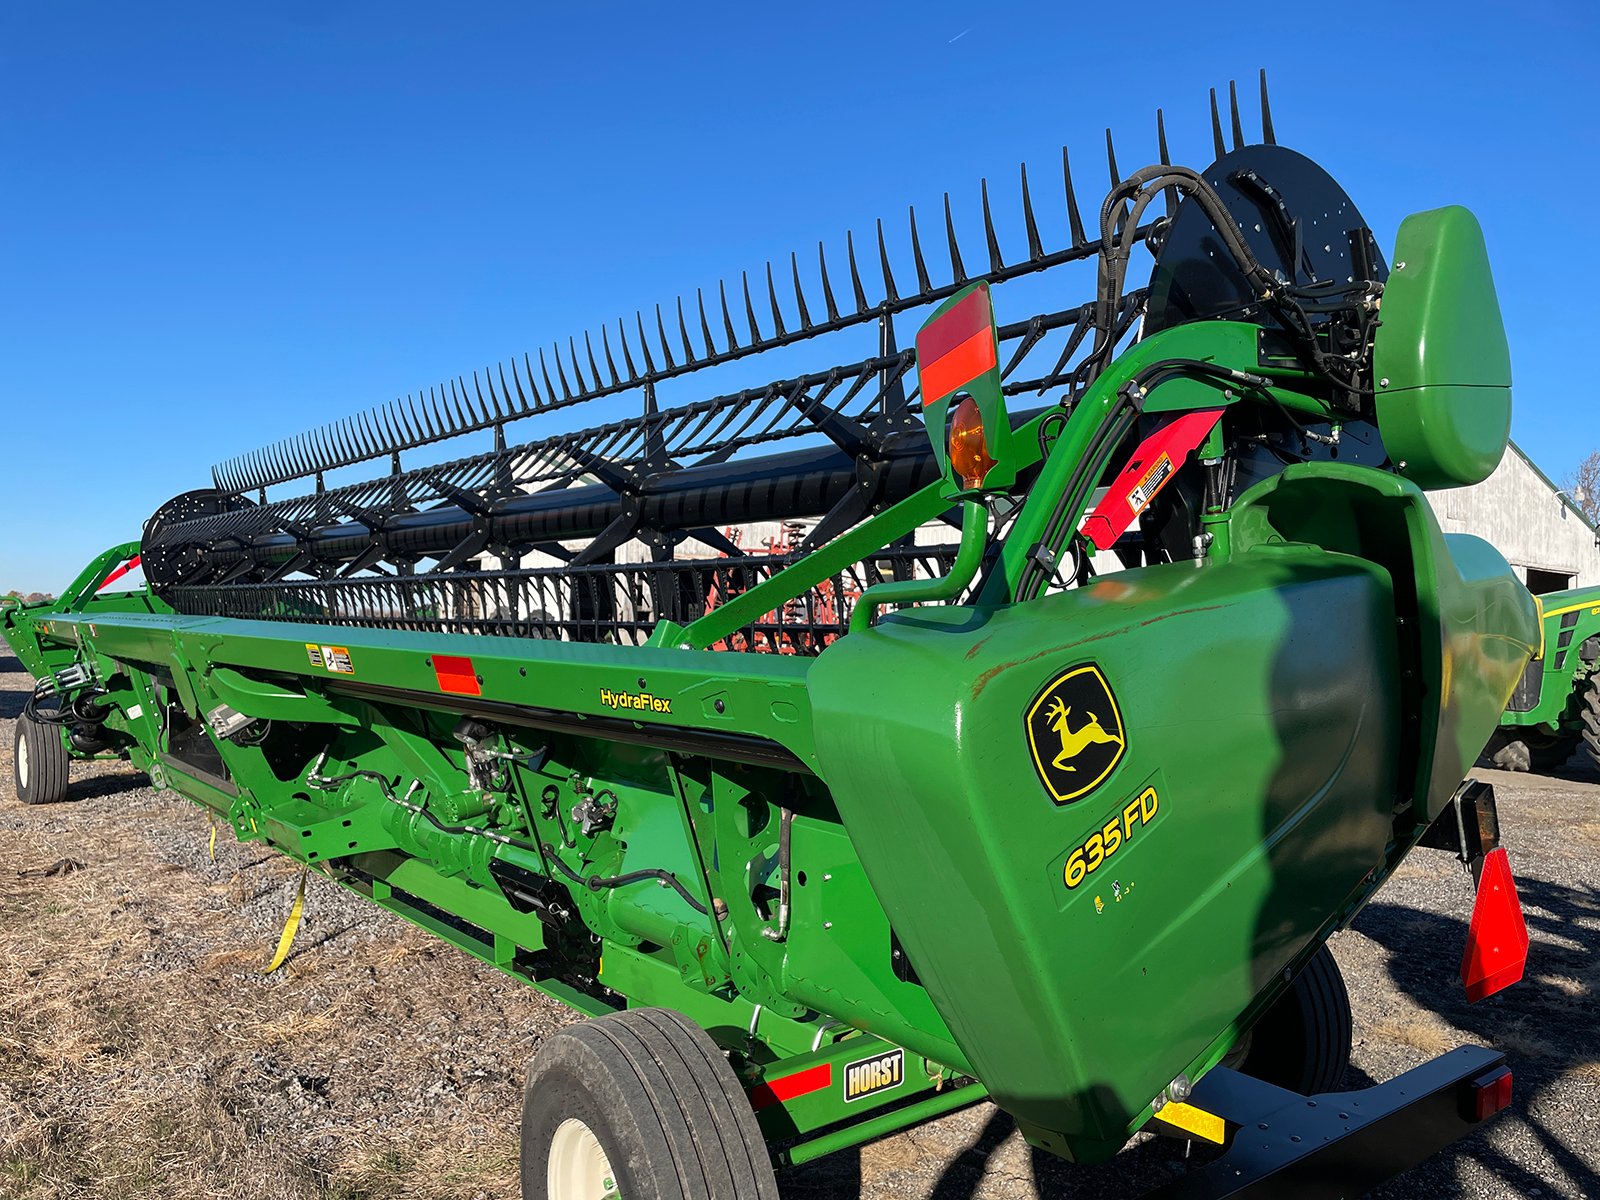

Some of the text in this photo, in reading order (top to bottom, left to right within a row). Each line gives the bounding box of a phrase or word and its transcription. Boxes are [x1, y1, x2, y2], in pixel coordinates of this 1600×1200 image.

[600, 688, 672, 714] HydraFlex
[1064, 785, 1159, 890] 635FD
[848, 1053, 902, 1097] HORST
